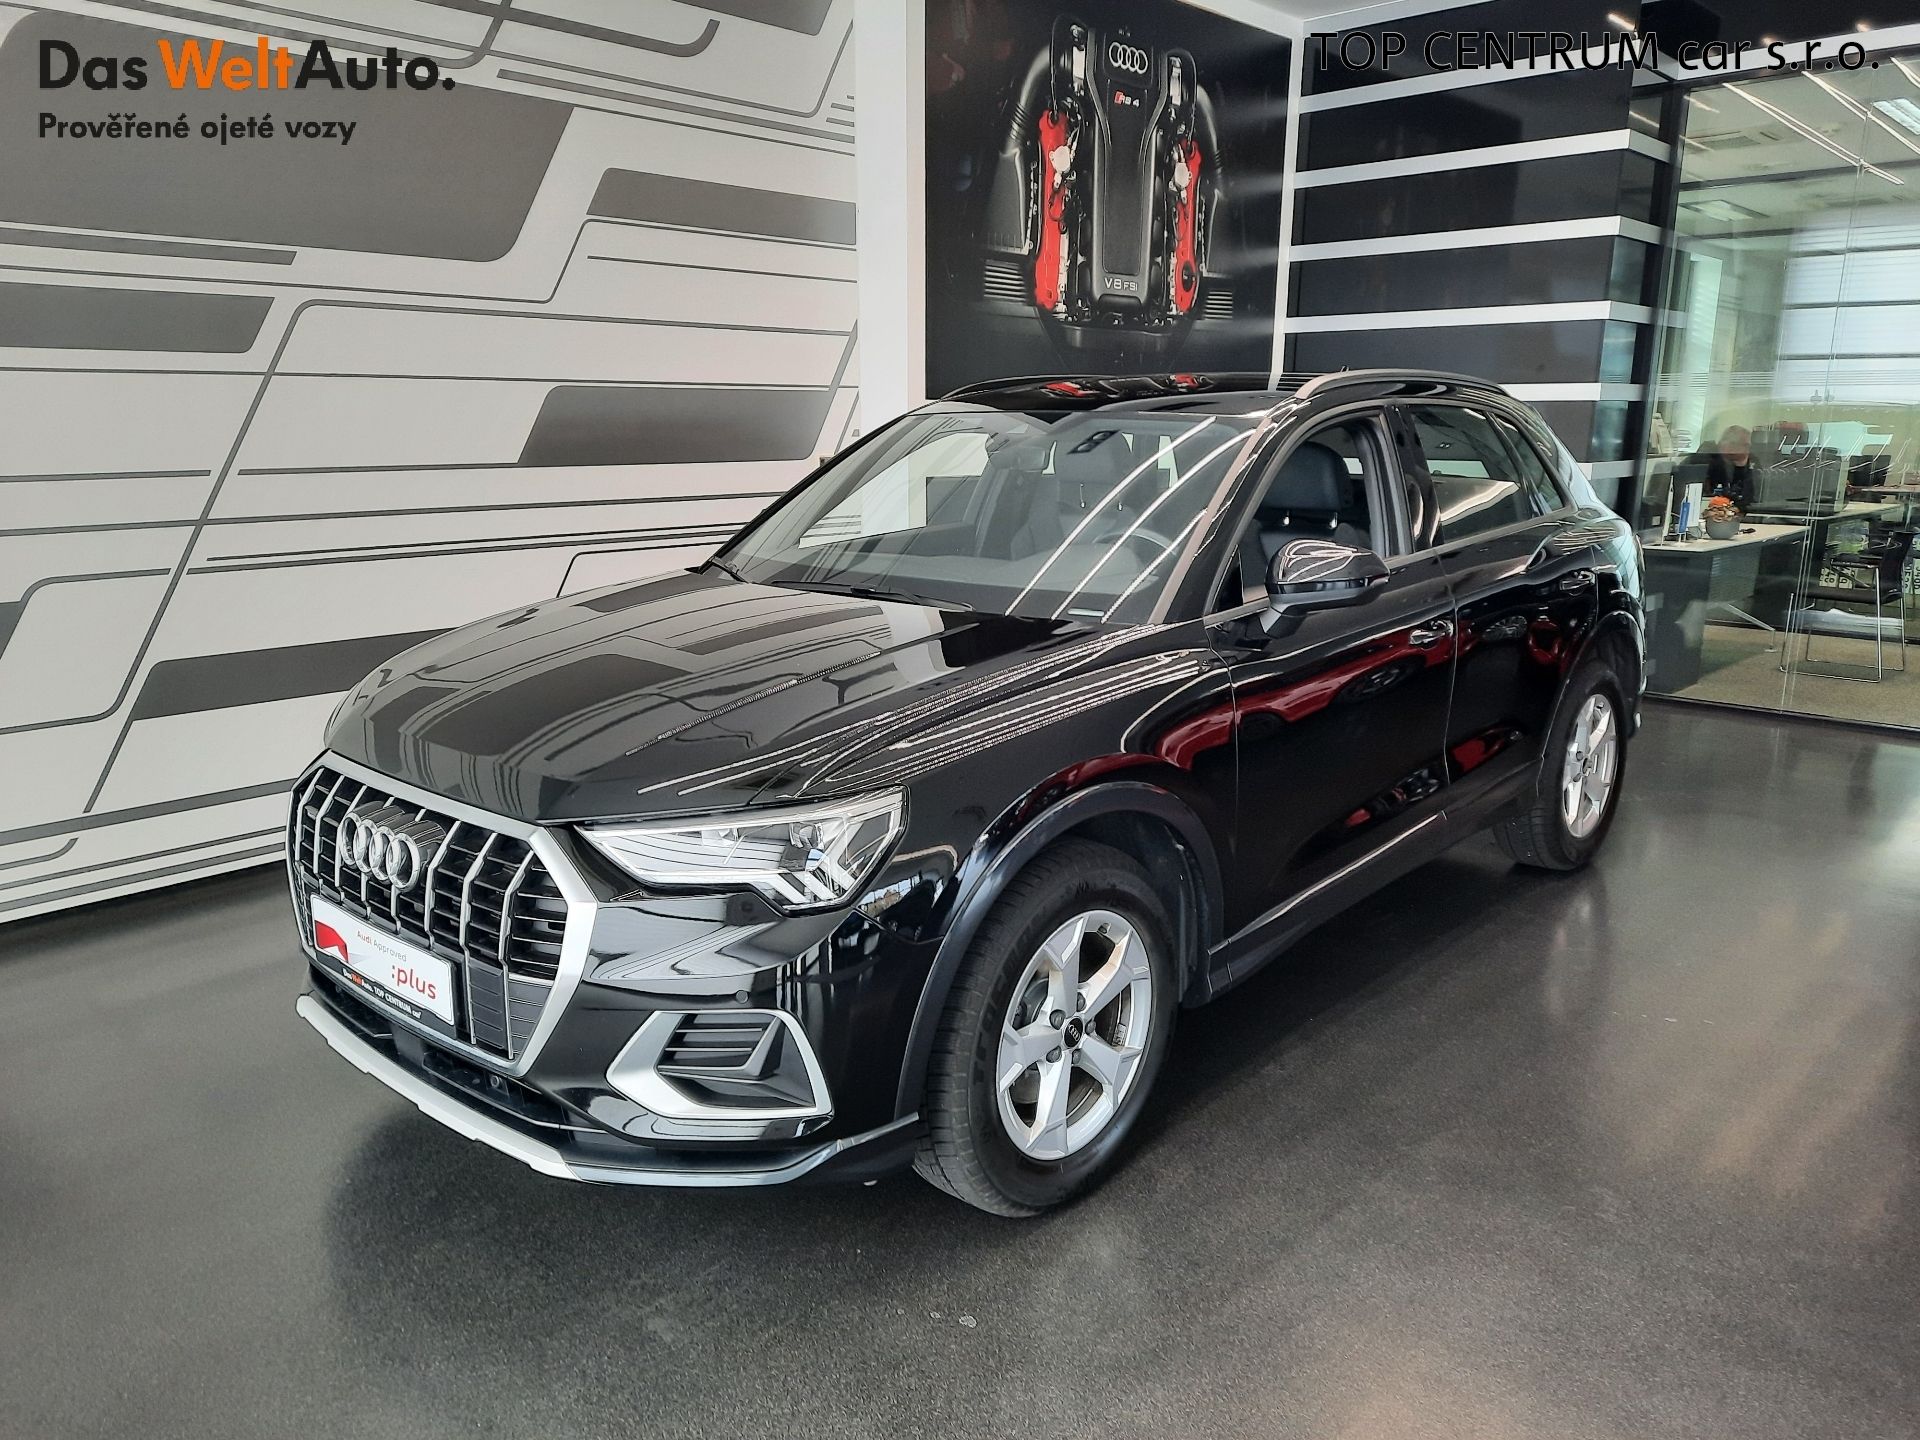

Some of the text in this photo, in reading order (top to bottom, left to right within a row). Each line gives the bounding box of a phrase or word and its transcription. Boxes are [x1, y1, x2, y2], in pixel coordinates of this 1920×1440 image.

[1104, 277, 1122, 290] V8
[357, 930, 407, 962] Audi Approved
